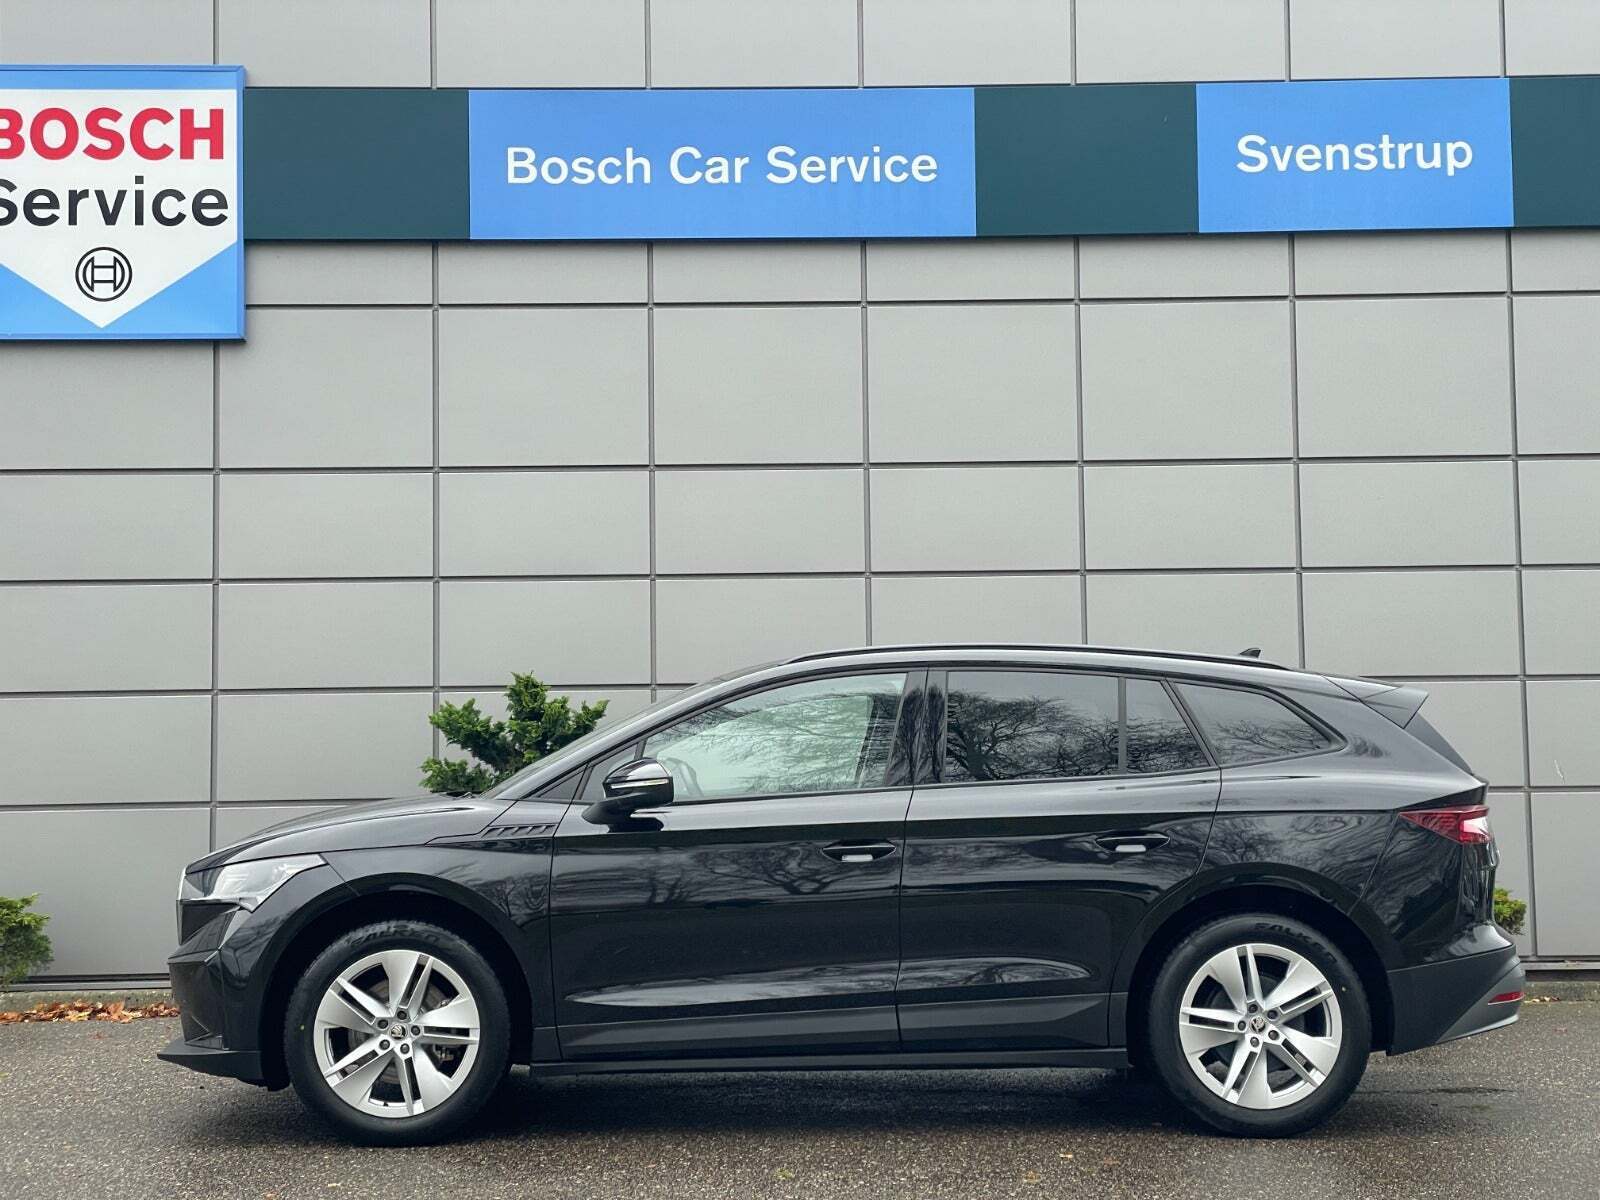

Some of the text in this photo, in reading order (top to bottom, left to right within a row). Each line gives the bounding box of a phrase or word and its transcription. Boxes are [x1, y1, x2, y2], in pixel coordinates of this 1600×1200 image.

[0, 107, 224, 161] BOSCH
[1236, 134, 1473, 176] Svenstrup
[506, 145, 938, 185] Bosch Car Service
